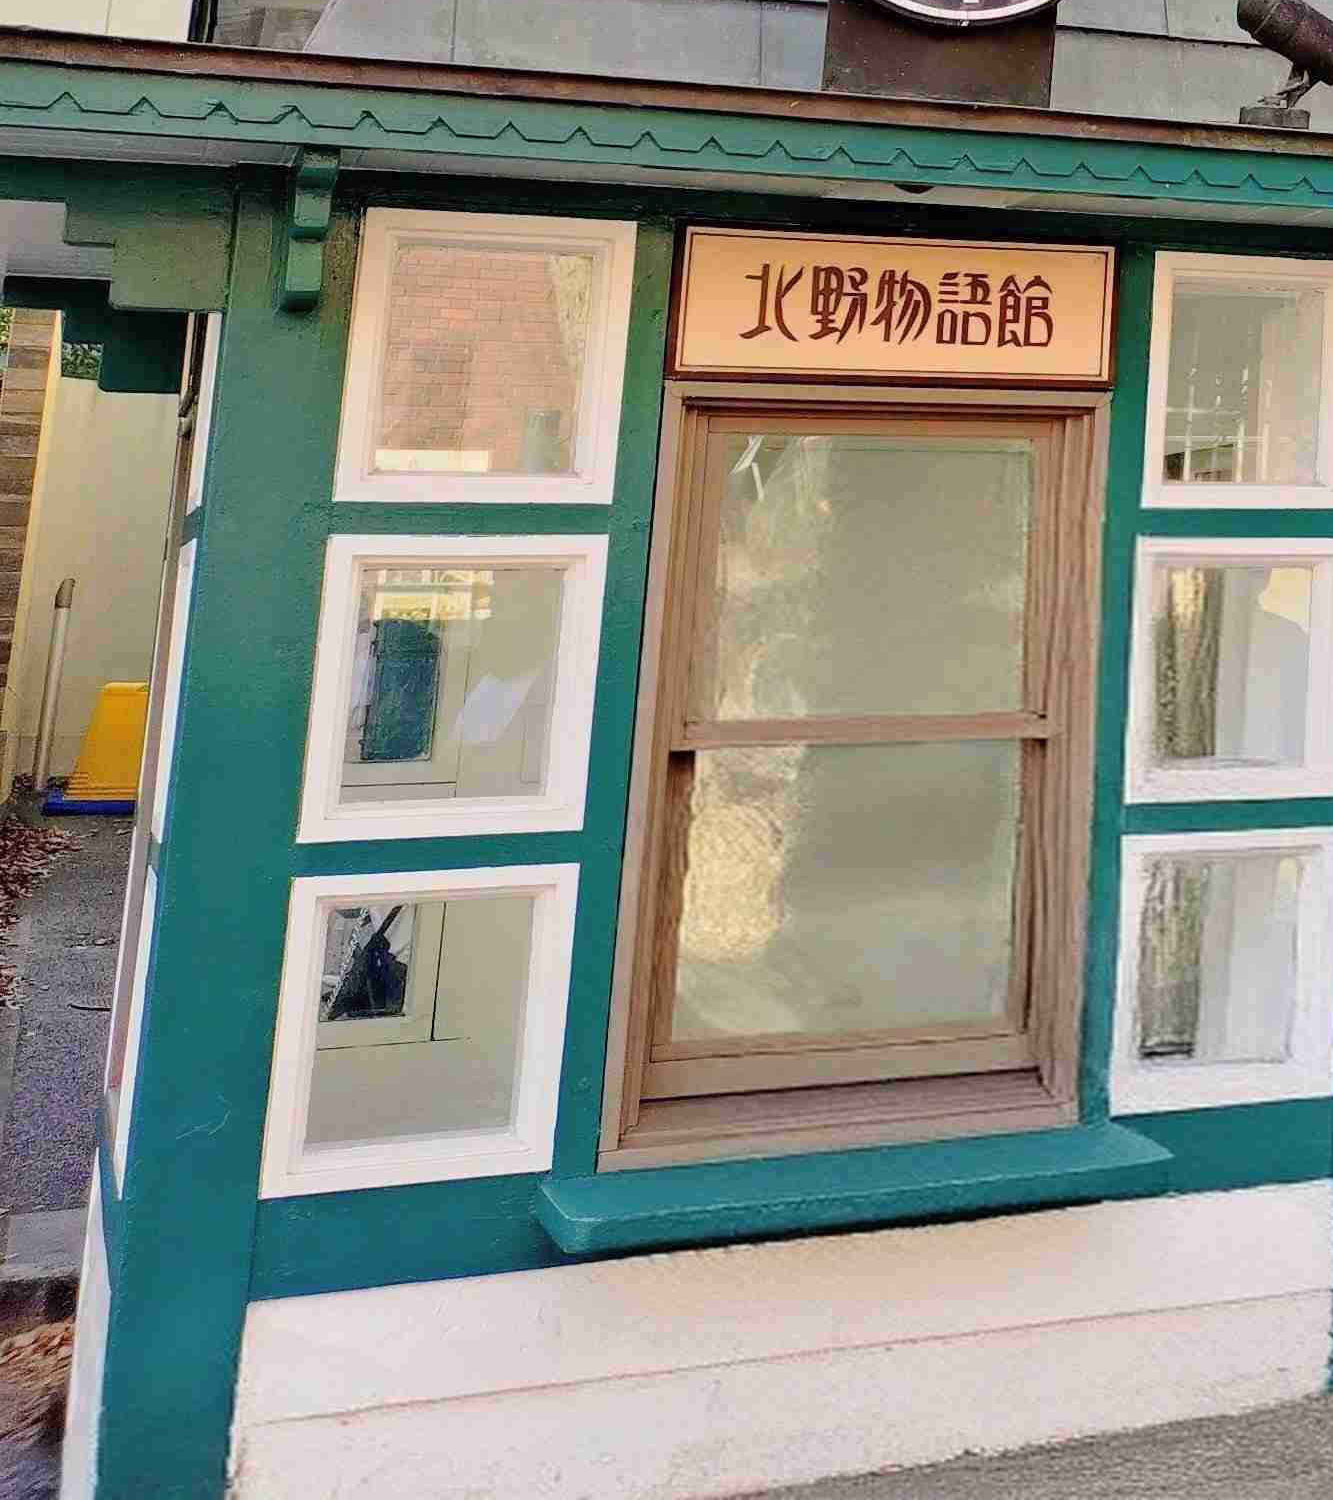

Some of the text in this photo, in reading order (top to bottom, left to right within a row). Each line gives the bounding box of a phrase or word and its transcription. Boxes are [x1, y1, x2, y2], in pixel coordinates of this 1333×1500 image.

[739, 261, 1054, 348] 北野物語館
